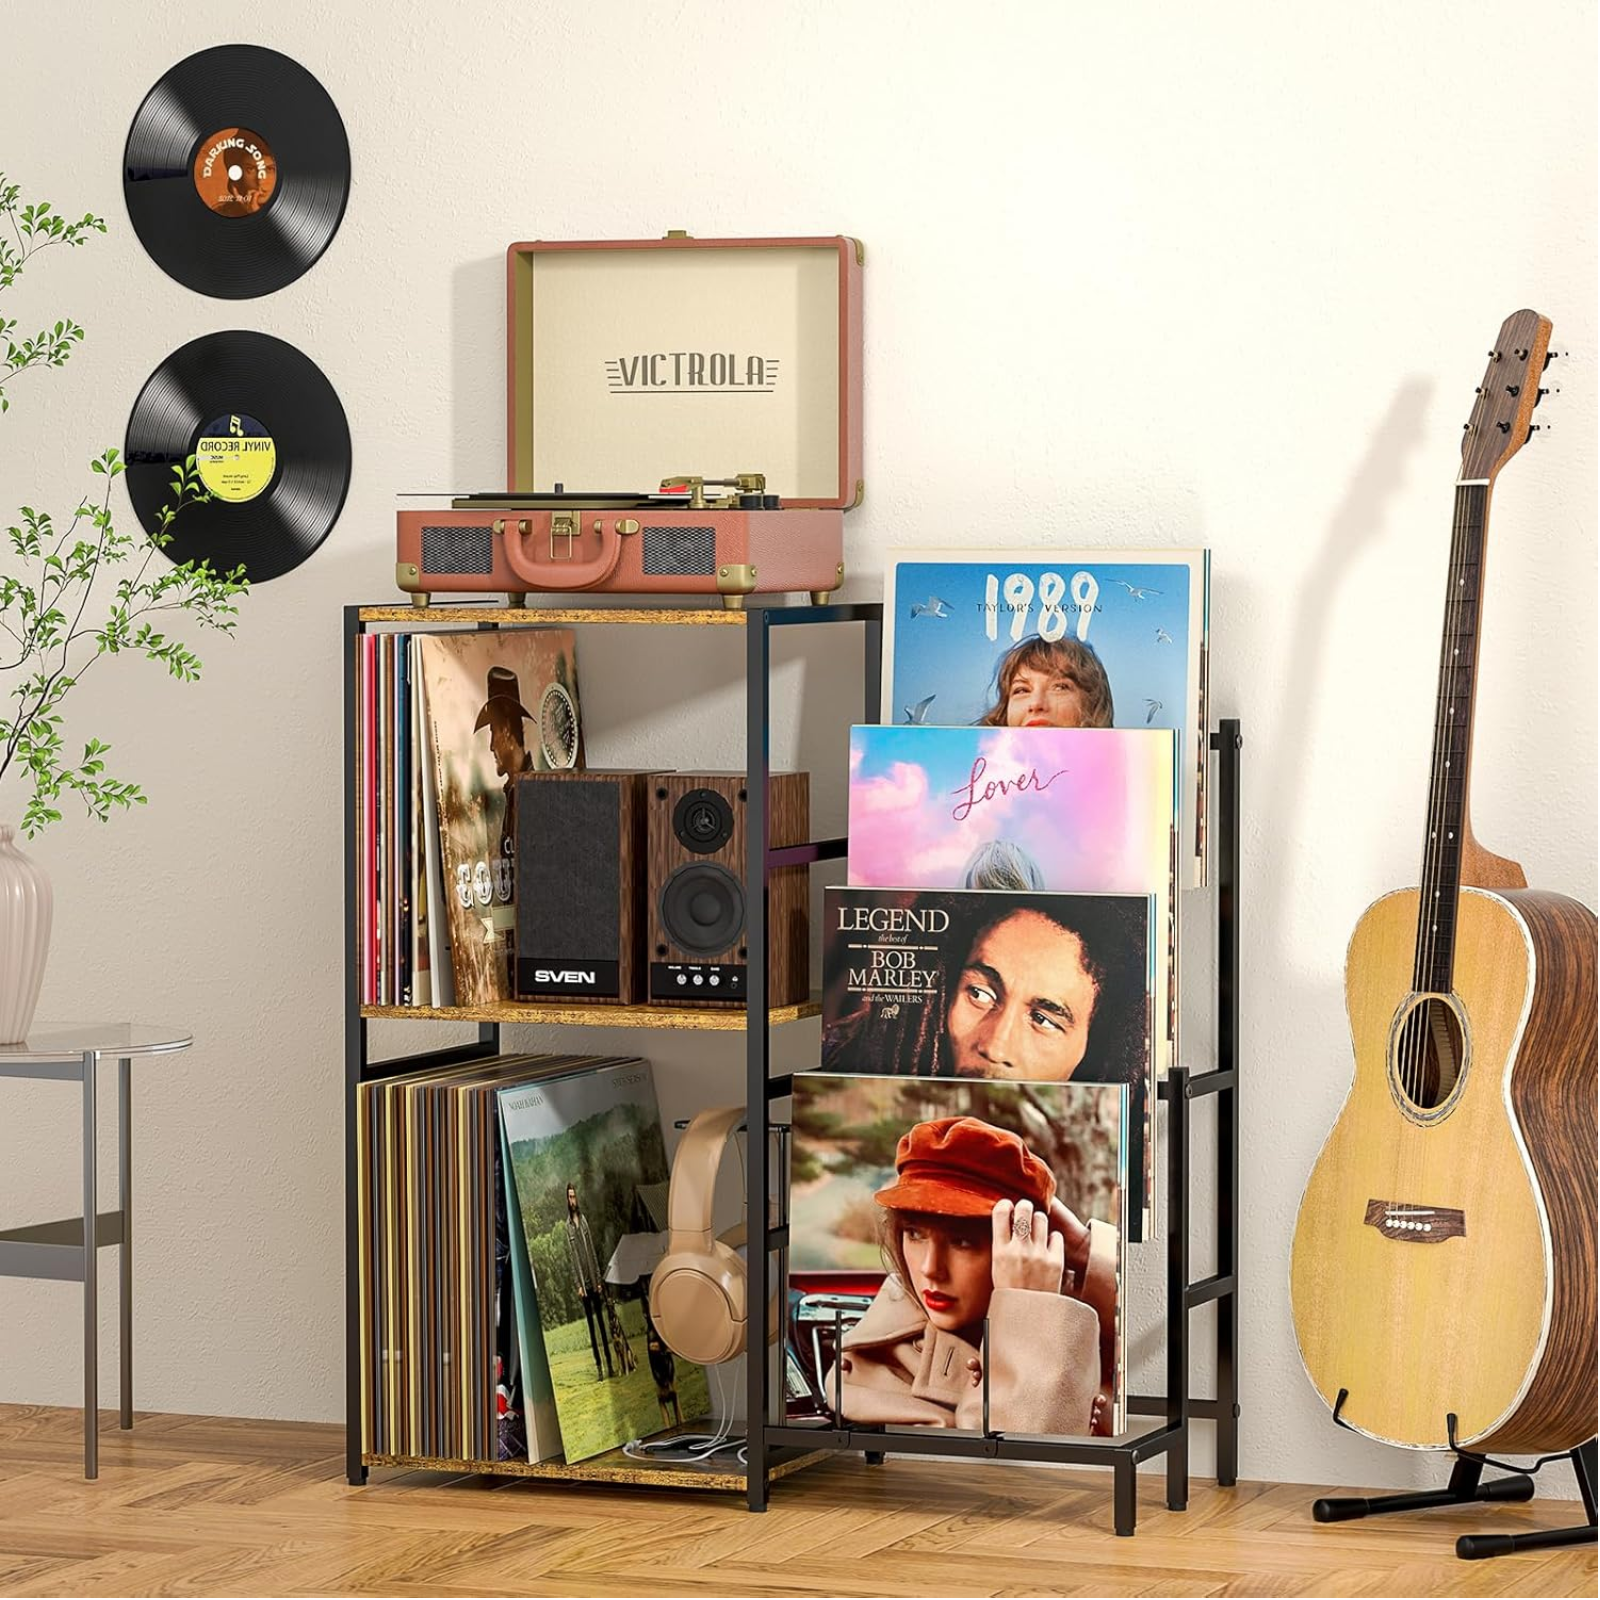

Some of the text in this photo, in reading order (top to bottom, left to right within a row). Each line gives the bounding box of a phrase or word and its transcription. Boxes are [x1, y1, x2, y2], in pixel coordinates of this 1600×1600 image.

[203, 138, 267, 180] DARKING SONG
[619, 352, 764, 386] VICTROLA
[977, 603, 1103, 613] TAYLOR'S VERSION
[985, 570, 1100, 643] 1989
[951, 756, 1069, 821] Lover
[837, 907, 950, 933] LEGEND
[870, 950, 917, 970] BOB
[535, 969, 596, 984] SVEN
[848, 968, 937, 988] MARLEY
[884, 994, 923, 1004] WAILERS
